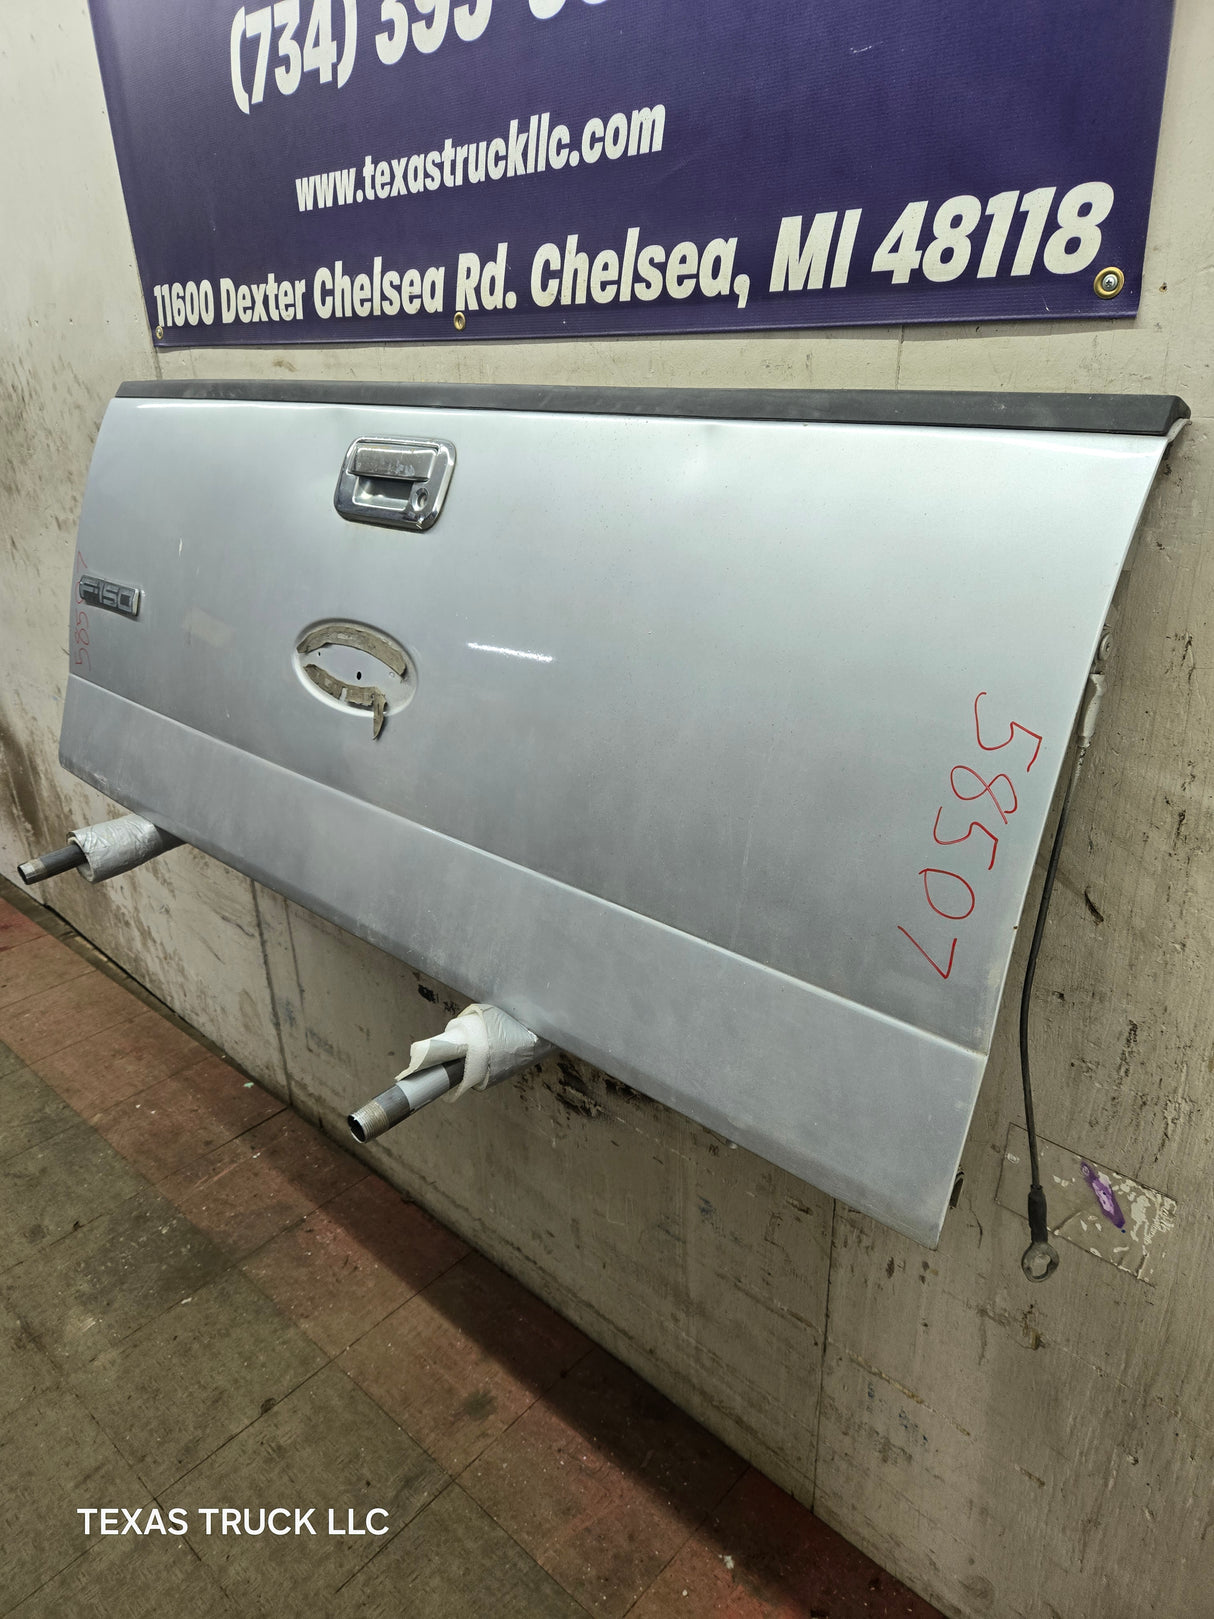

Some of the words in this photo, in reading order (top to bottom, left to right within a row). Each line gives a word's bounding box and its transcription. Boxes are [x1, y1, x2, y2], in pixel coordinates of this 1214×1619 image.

[228, 0, 358, 115] (734)
[295, 103, 666, 212] www.texastruckllc.com
[153, 279, 215, 327] 11600
[219, 272, 306, 324] Dexter
[313, 255, 446, 319] Chelsea
[455, 242, 517, 312] Rd.
[530, 226, 751, 309] Chelsea,
[768, 207, 863, 293] MI
[871, 181, 1115, 285] 48118
[897, 691, 1043, 979] 58507
